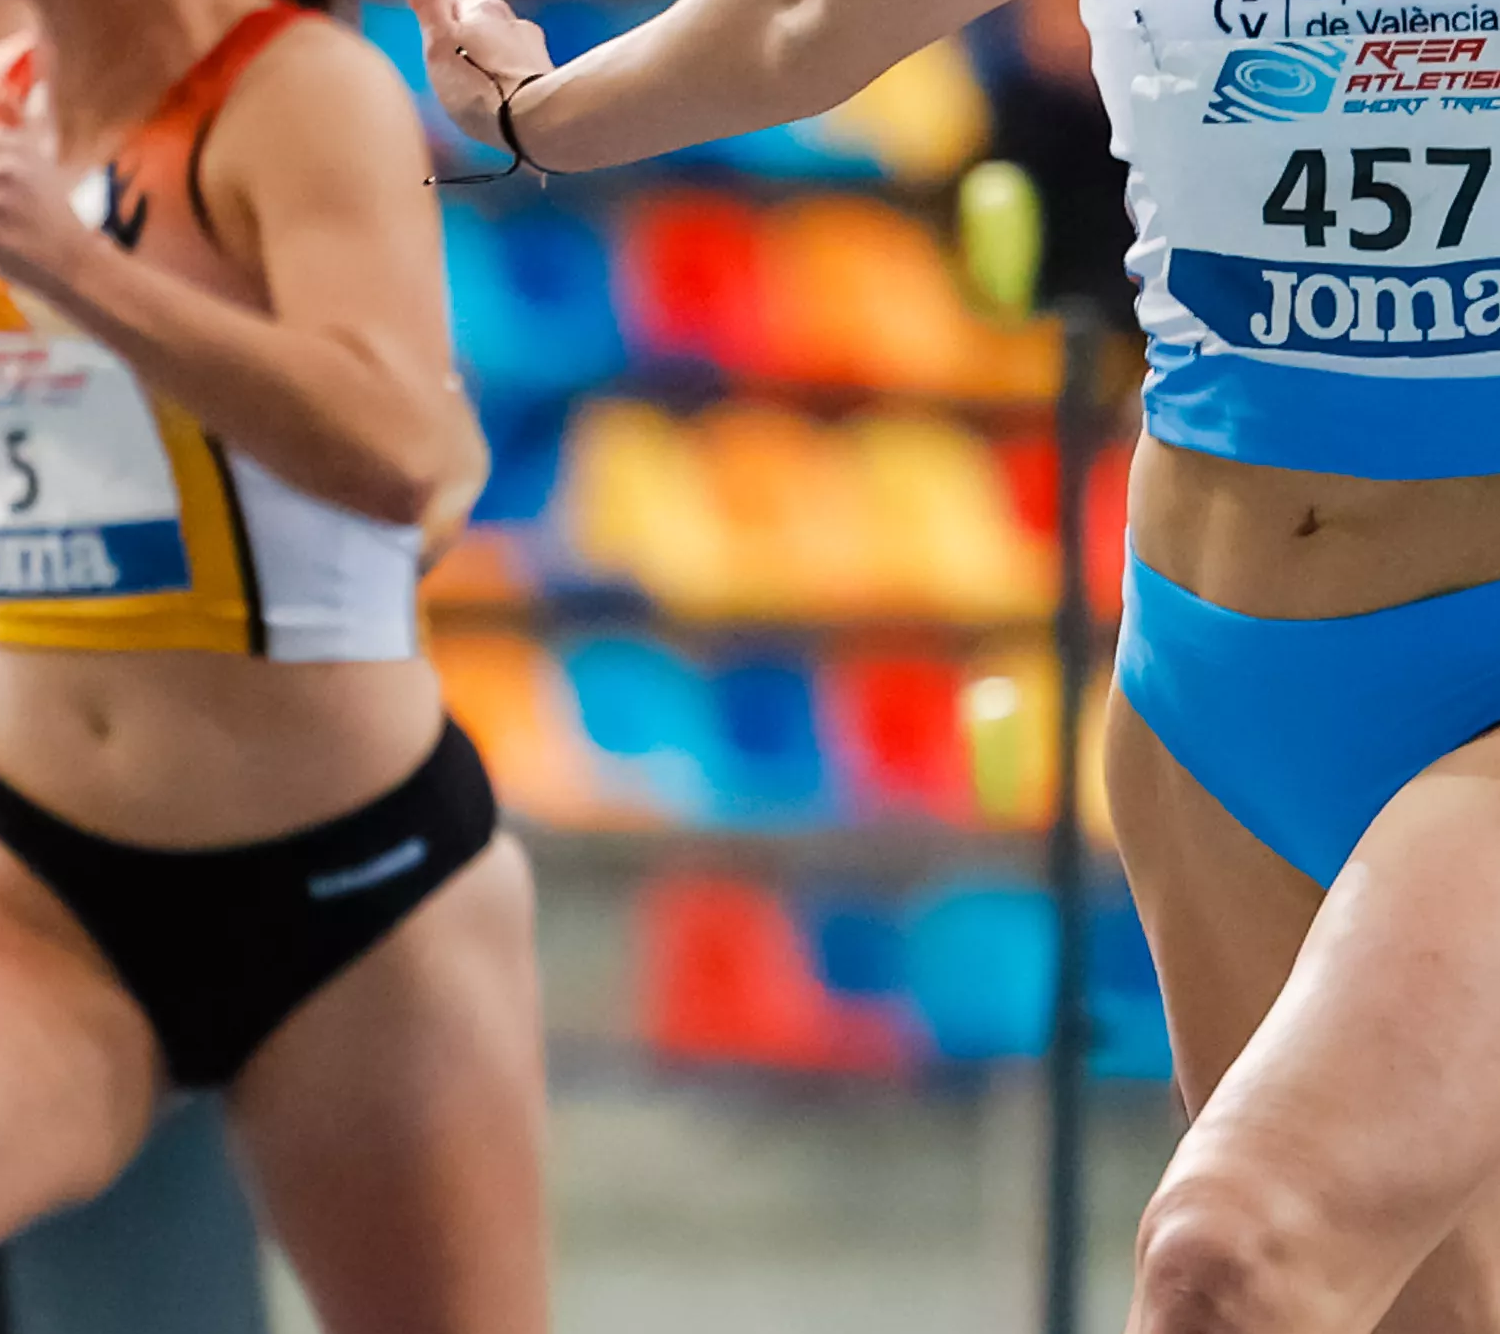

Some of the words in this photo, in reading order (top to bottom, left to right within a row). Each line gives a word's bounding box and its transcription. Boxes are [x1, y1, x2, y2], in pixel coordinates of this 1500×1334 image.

[1306, 12, 1349, 36] de
[1356, 4, 1499, 35] València
[1355, 38, 1487, 70] RFEA
[1342, 97, 1428, 115] SHORT
[1262, 147, 1491, 251] 457
[6, 430, 39, 513] 5
